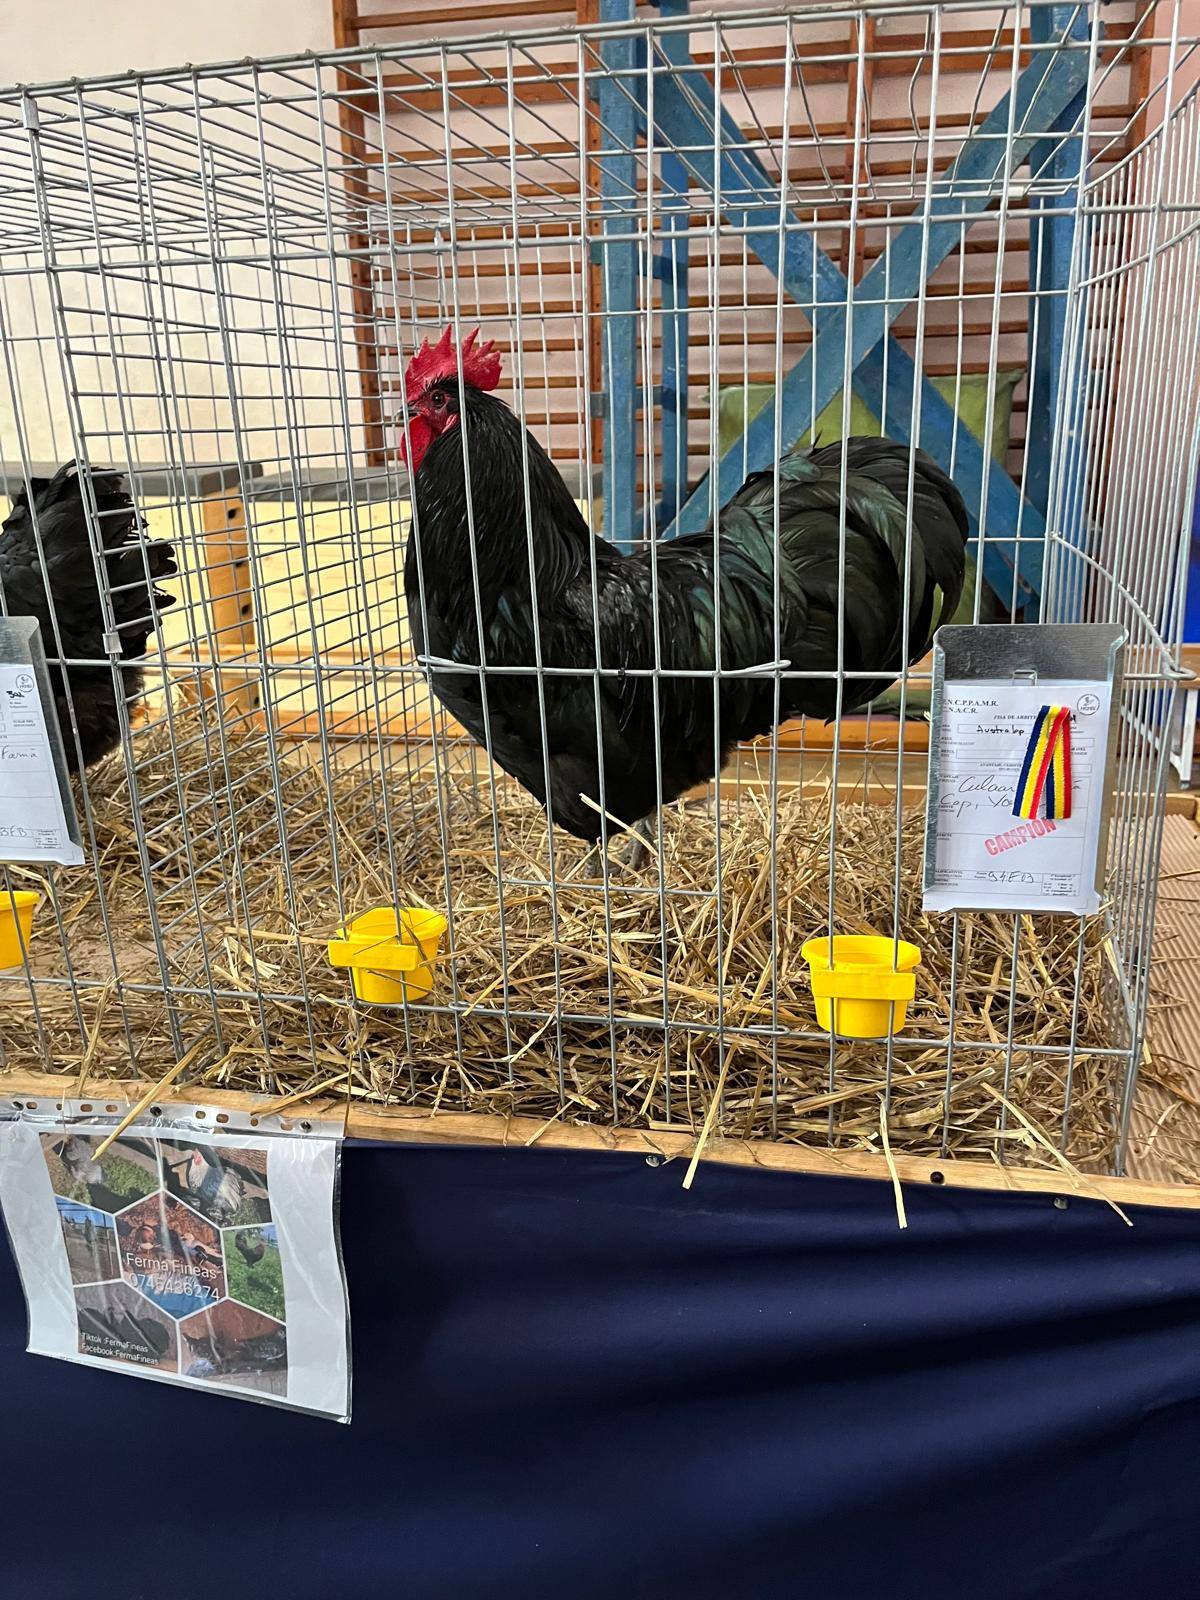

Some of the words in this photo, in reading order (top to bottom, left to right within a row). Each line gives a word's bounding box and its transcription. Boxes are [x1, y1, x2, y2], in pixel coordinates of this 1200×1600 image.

[984, 817, 1057, 856] CAMPION
[126, 1252, 169, 1272] Ferma
[172, 1259, 218, 1280] Fineas
